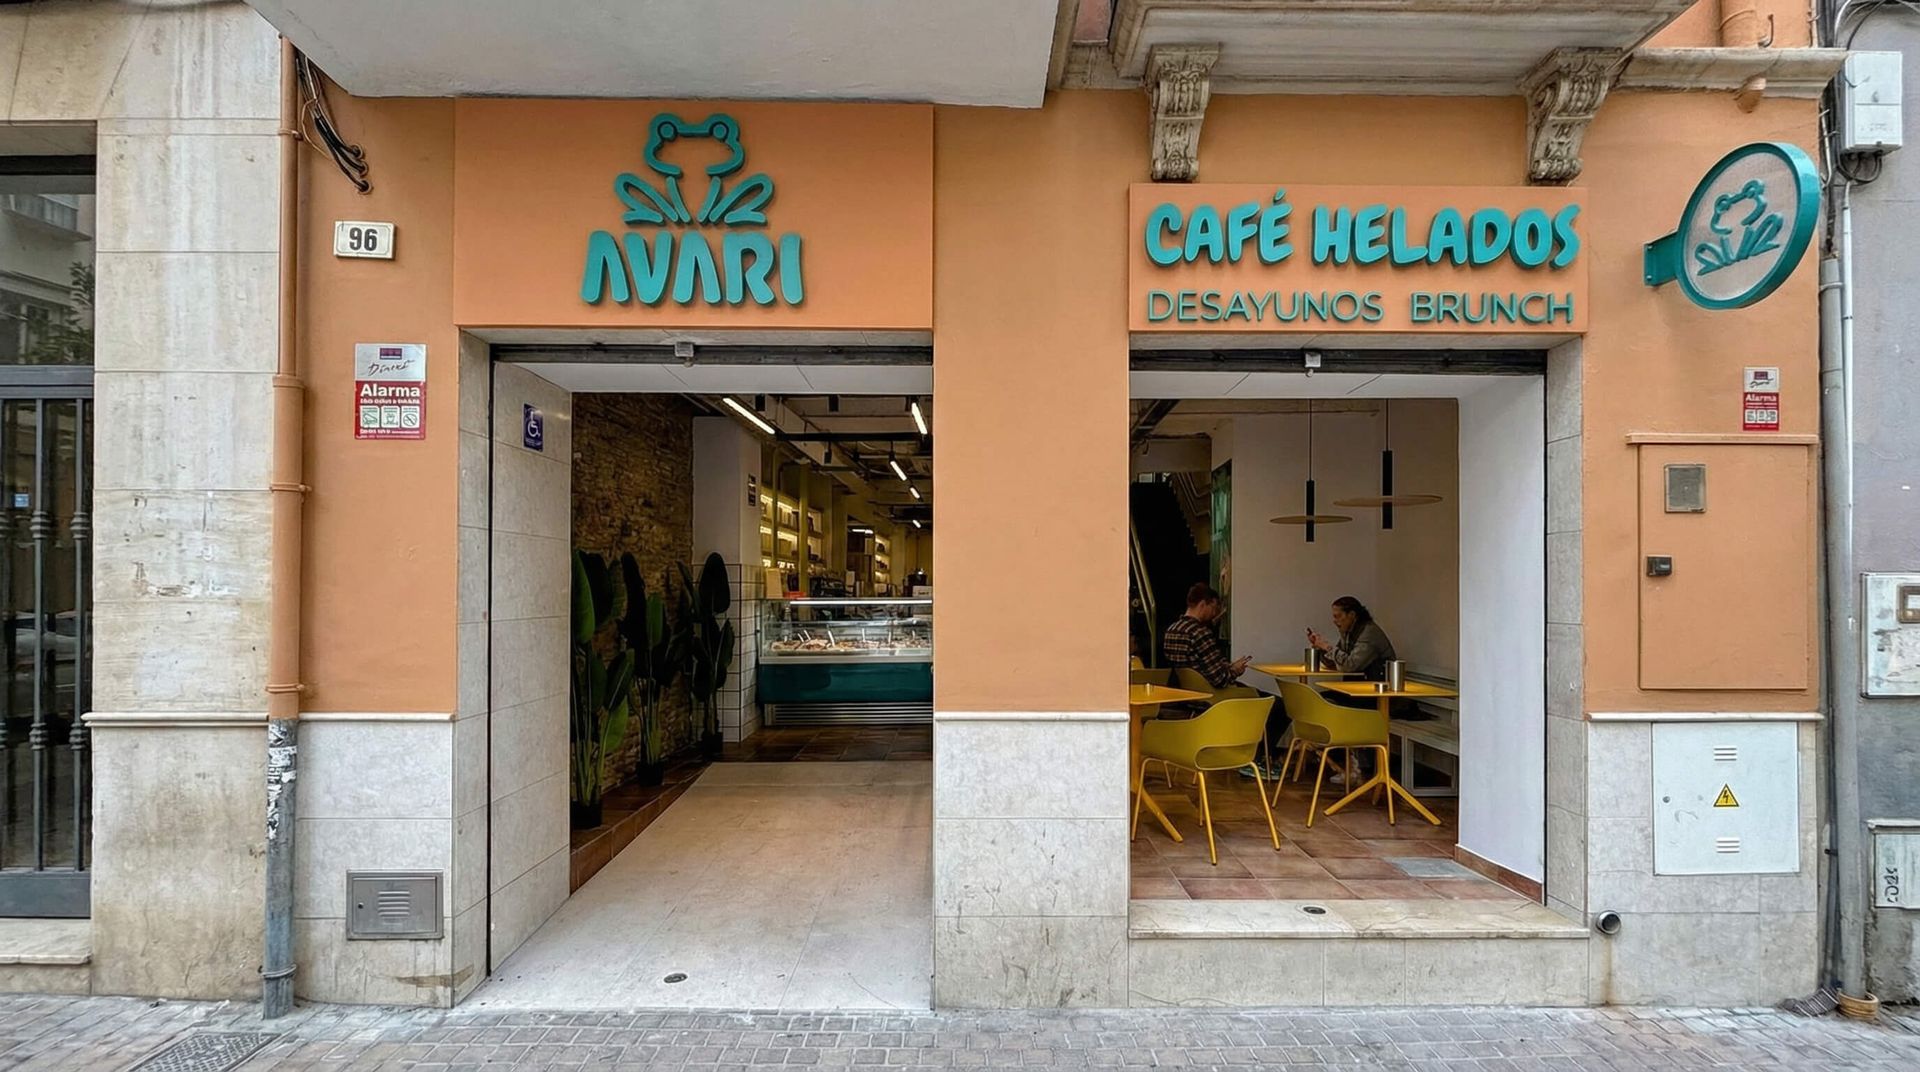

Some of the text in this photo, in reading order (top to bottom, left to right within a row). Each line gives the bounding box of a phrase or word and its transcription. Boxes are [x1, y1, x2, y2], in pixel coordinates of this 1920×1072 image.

[349, 227, 378, 251] 96
[1146, 189, 1582, 269] CAFÉ HELADOS
[581, 230, 804, 305] AVARI
[1148, 291, 1575, 323] DESAYUNOS BRUNCH
[360, 383, 420, 397] Alarma
